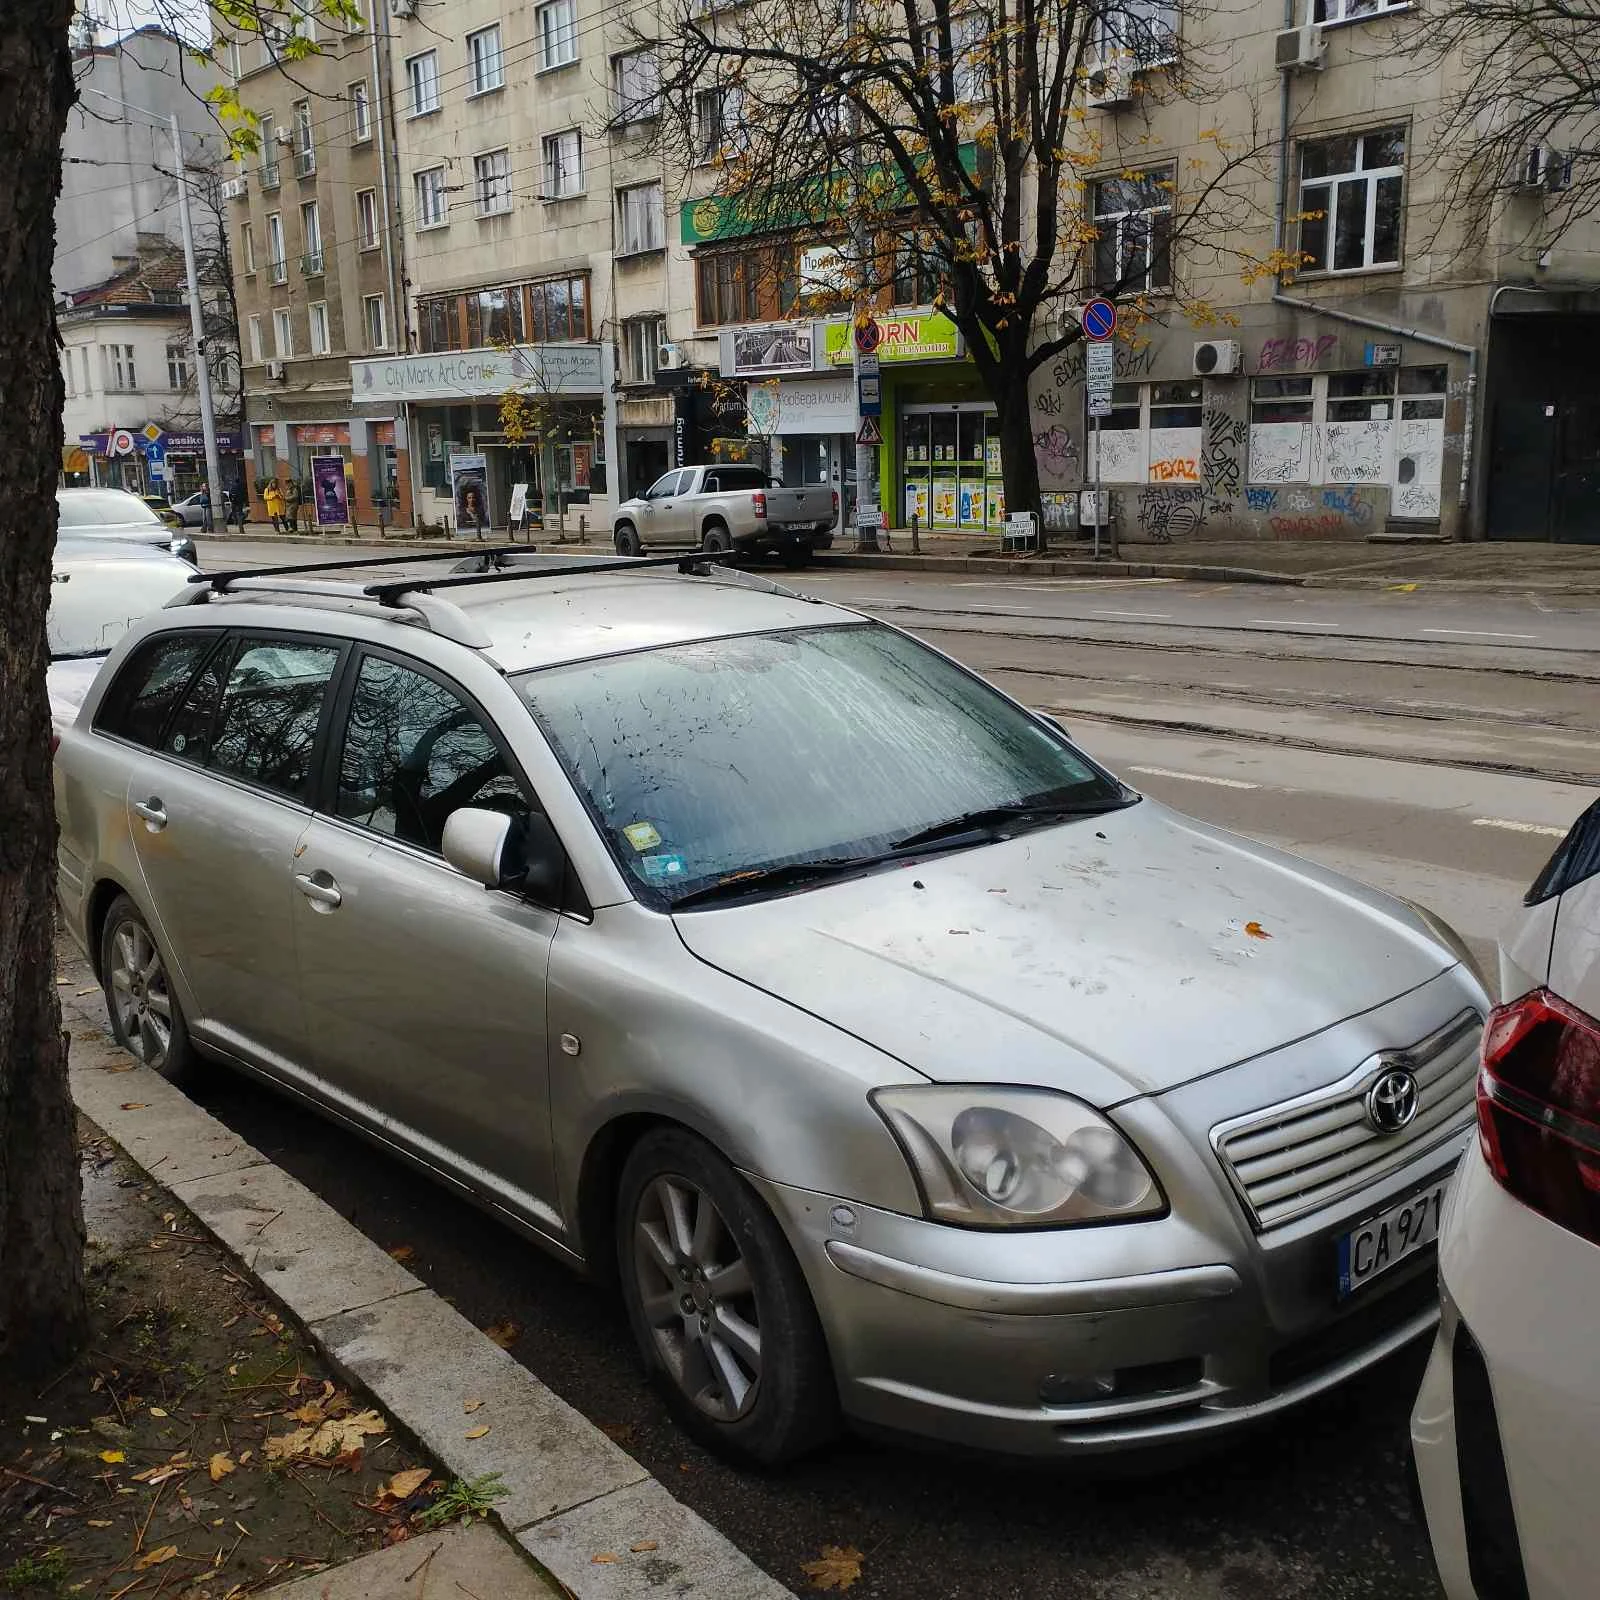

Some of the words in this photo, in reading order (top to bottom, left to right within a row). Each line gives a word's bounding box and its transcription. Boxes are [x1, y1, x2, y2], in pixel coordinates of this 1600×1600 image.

[384, 366, 405, 389] City
[406, 363, 434, 385] Mark
[439, 359, 457, 383] Art
[1354, 1221, 1389, 1277] CA
[1399, 1188, 1441, 1252] 971
